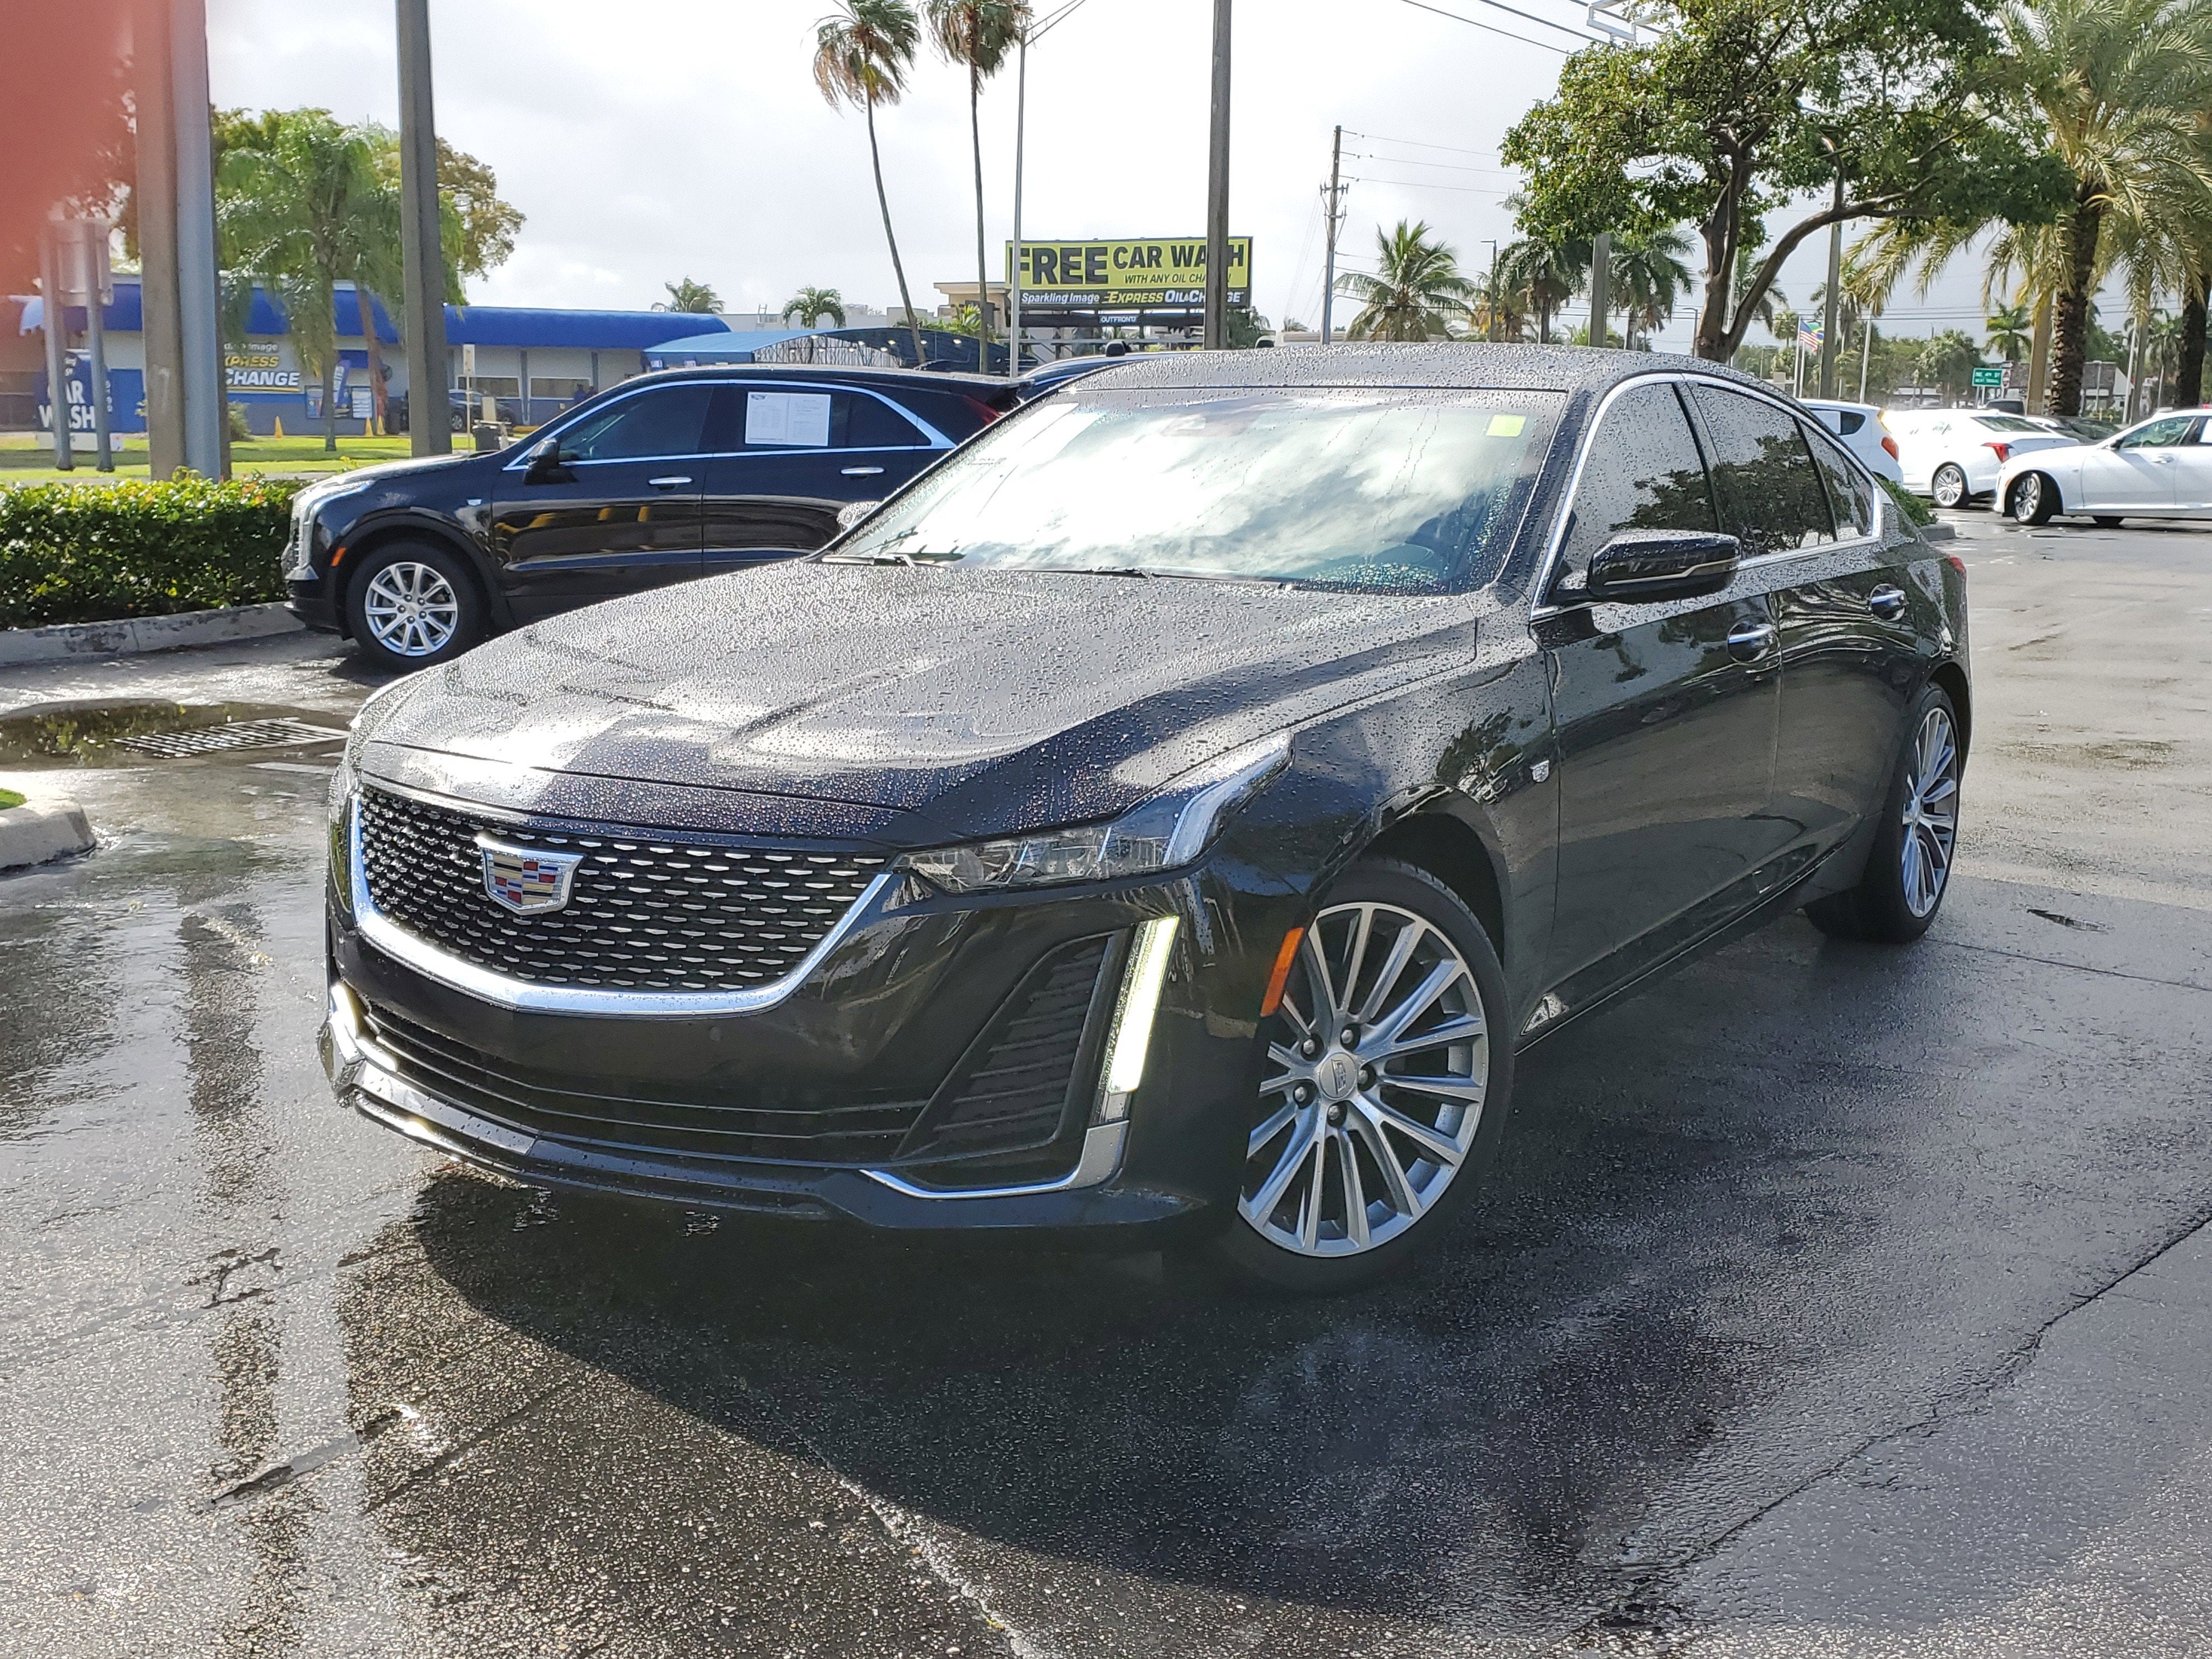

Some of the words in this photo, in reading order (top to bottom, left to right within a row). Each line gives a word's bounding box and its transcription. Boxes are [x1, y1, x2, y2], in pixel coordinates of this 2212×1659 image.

[1009, 247, 1108, 284] FREE
[1113, 246, 1163, 269] CAR
[1171, 244, 1244, 268] WAH
[1125, 274, 1148, 284] WITH
[1149, 274, 1170, 283] ANY
[1172, 273, 1186, 283] OIL
[1022, 293, 1068, 304] Sparkling
[1069, 292, 1099, 304] Image
[1106, 291, 1164, 304] EXPRESS
[38, 404, 96, 429] WSH
